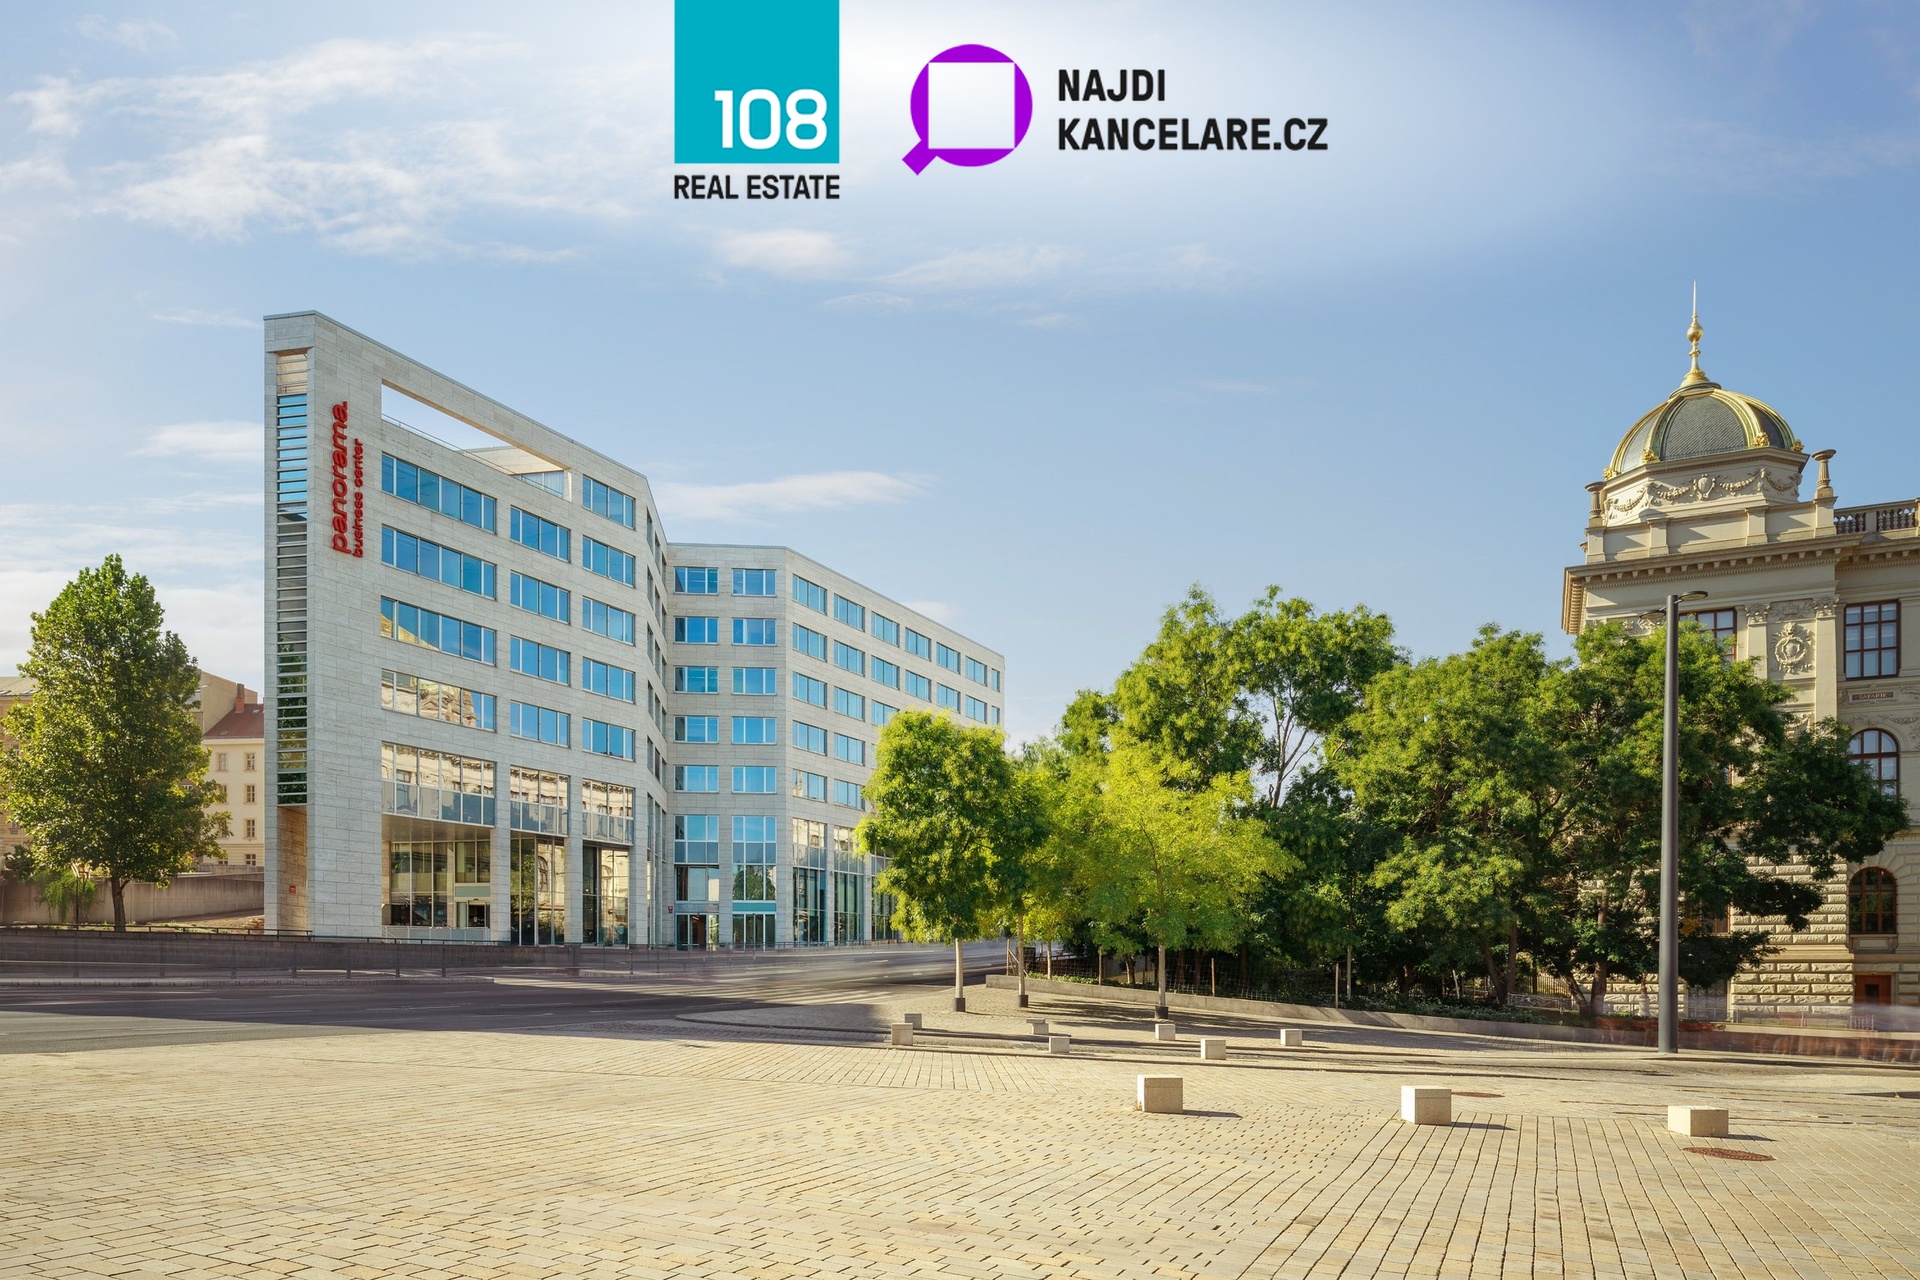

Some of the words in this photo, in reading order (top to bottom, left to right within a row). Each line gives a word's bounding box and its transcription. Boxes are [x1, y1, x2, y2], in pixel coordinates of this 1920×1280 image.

[332, 401, 352, 554] panorama
[353, 438, 364, 487] center
[352, 491, 364, 558] business
